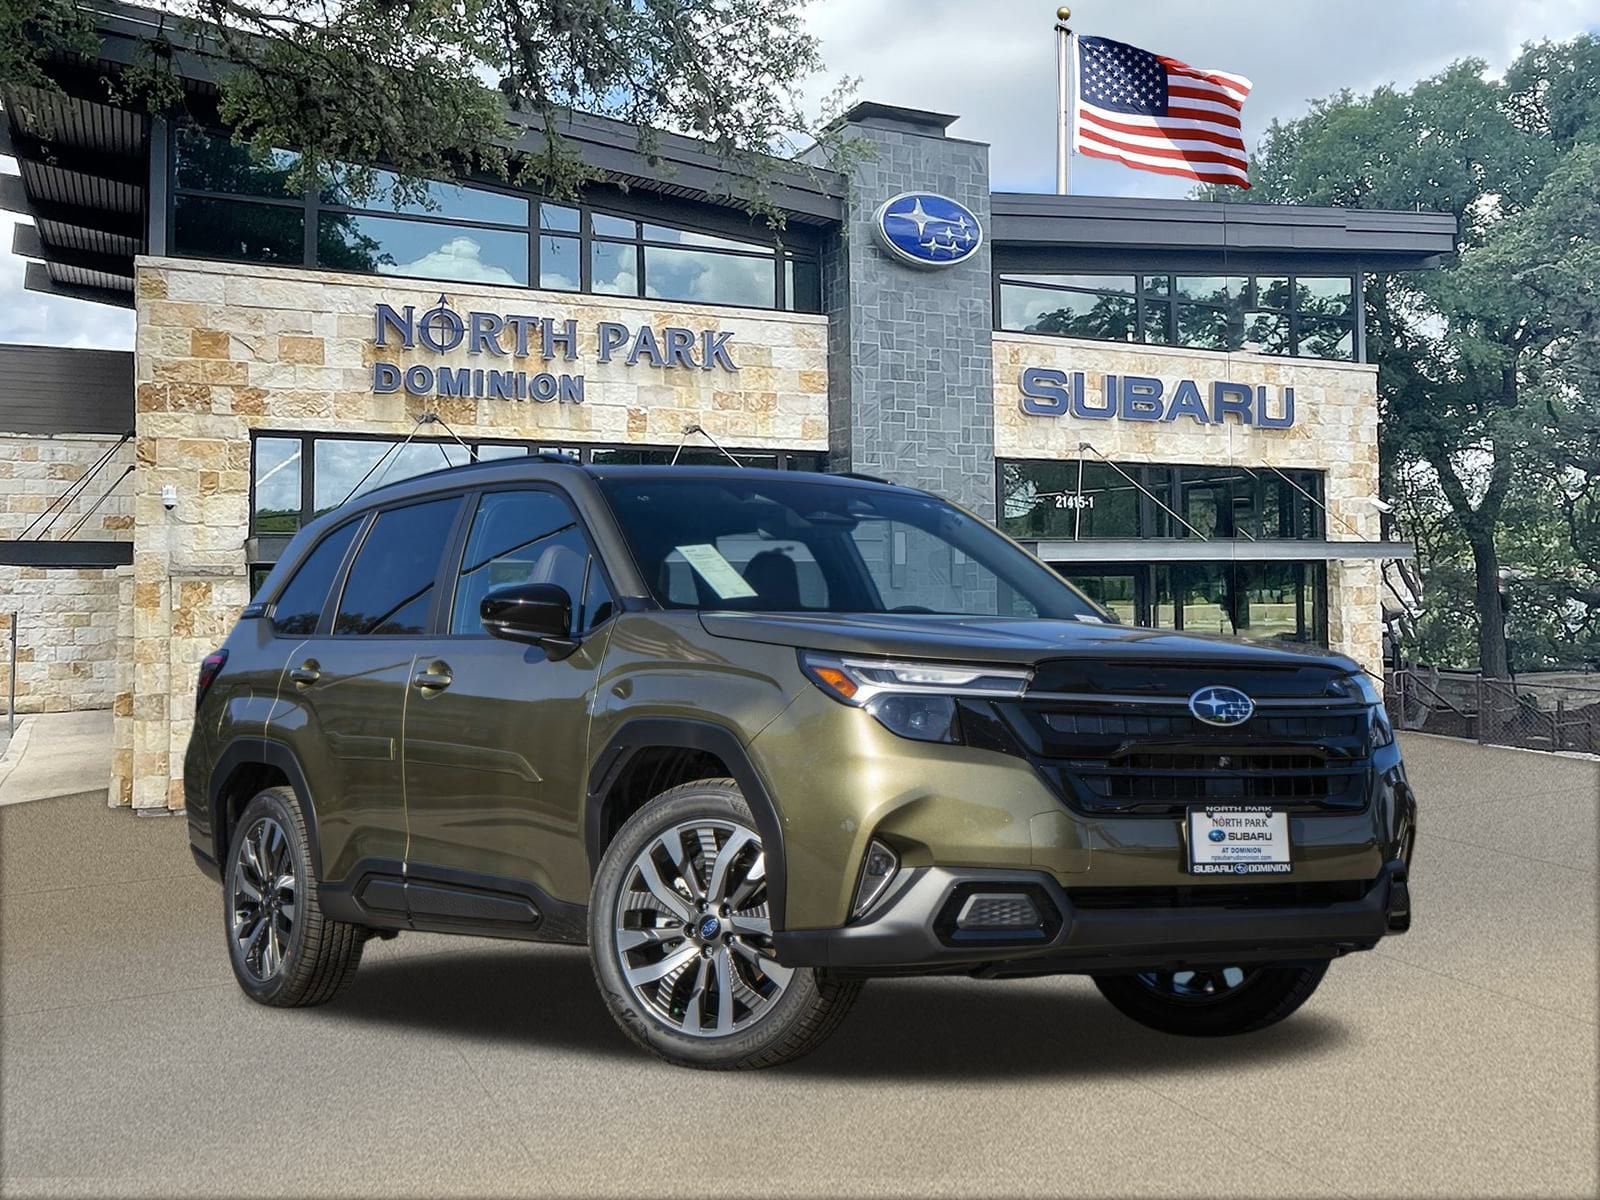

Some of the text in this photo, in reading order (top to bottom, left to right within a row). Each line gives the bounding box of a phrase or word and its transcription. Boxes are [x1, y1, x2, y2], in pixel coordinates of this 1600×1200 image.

[374, 297, 742, 372] NORTH PARK
[372, 361, 585, 404] DOMINION
[1018, 367, 1295, 429] SUBARU
[1212, 817, 1269, 828] NORTH PARK
[1228, 832, 1272, 841] SUBARU
[1193, 863, 1291, 873] SUBARU DOMINION
